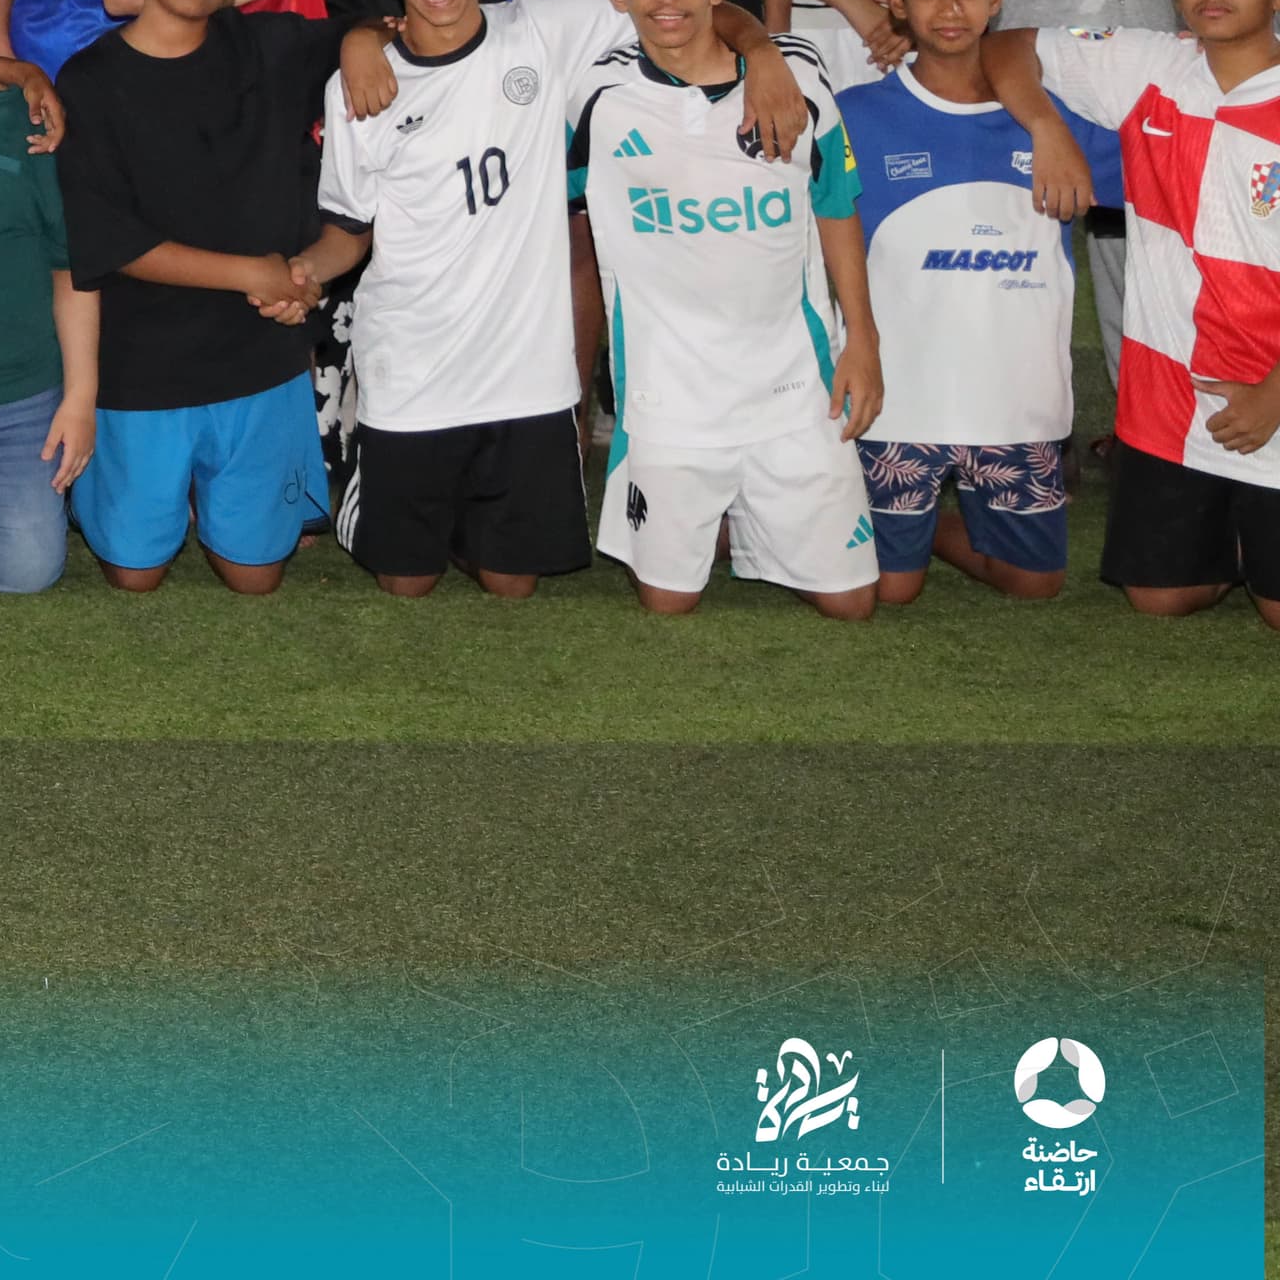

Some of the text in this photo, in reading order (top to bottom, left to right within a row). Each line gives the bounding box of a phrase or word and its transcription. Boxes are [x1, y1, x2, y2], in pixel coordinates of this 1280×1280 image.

[456, 146, 510, 215] 10
[677, 186, 792, 234] sela
[921, 249, 1038, 271] MASCOT
